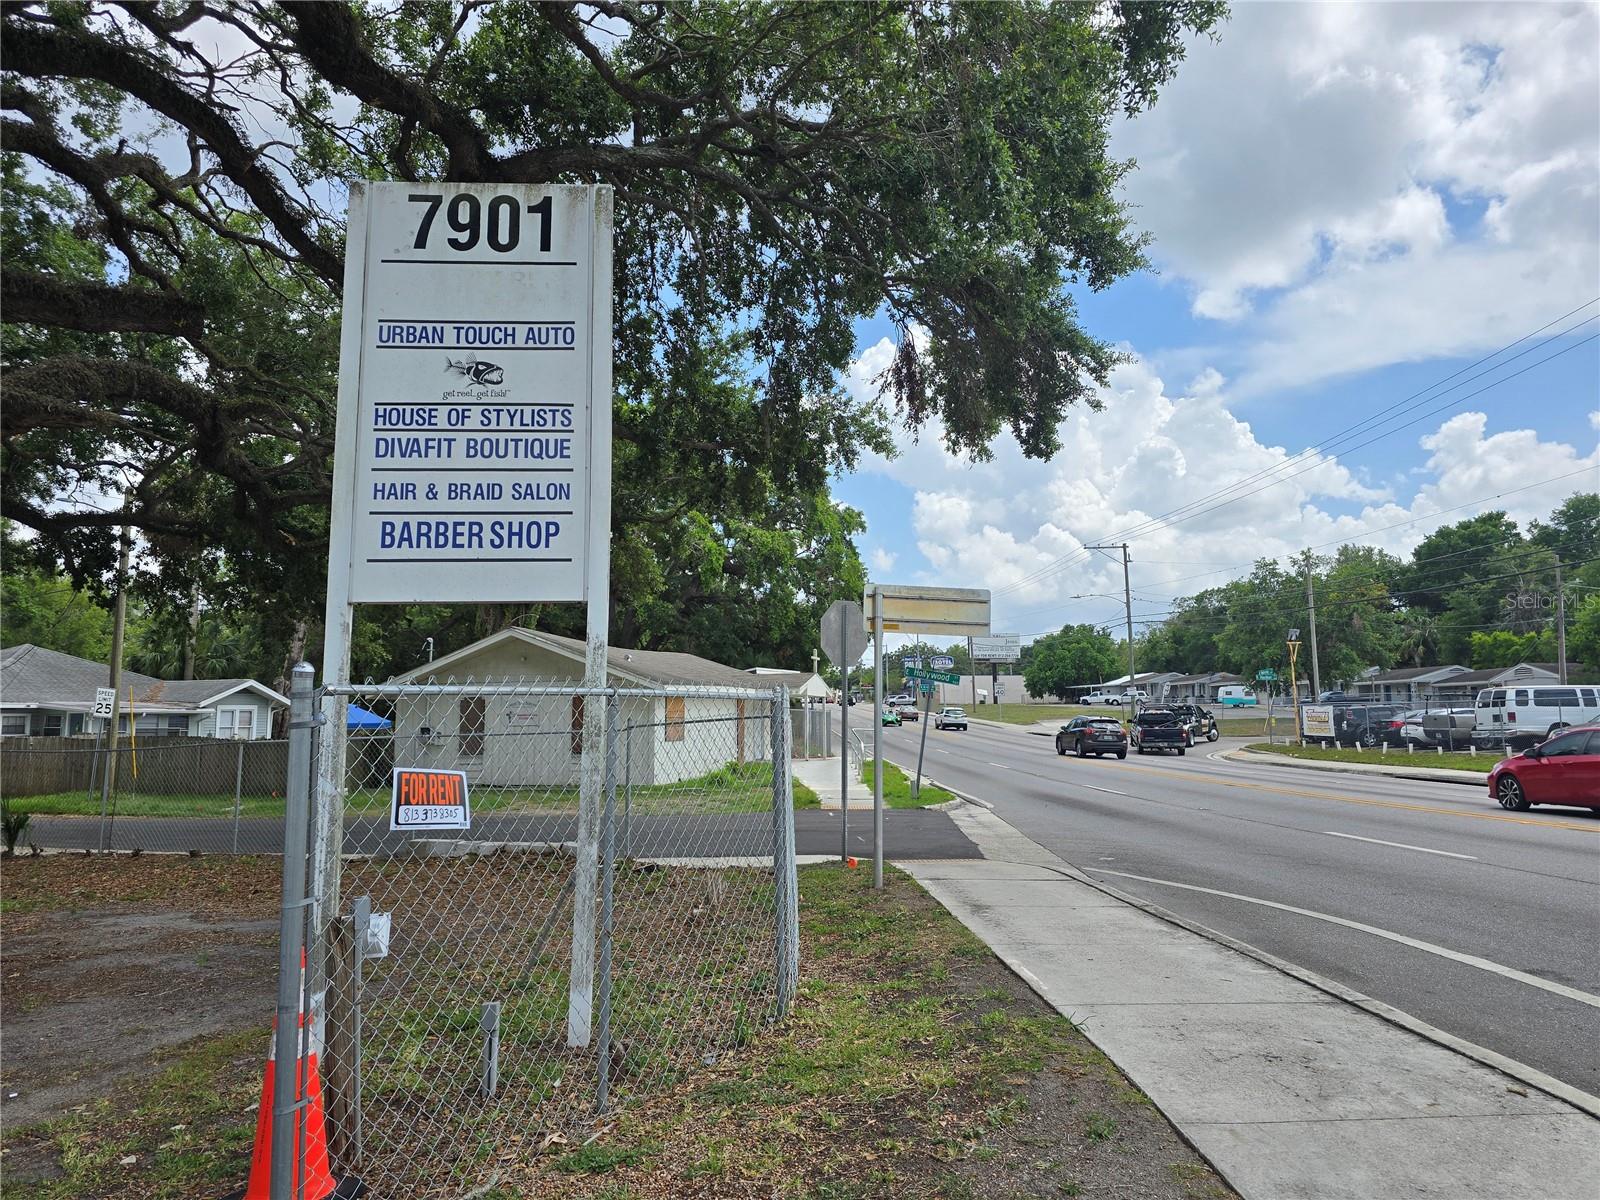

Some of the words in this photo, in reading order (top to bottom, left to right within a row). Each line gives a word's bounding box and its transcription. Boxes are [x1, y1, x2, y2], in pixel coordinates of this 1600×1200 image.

[408, 193, 553, 253] 7901
[378, 325, 445, 345] URBAN
[453, 326, 517, 345] TOUCH
[524, 326, 576, 346] AUTO
[442, 390, 456, 400] get
[374, 407, 439, 427] HOUSE
[447, 408, 472, 427] OF
[480, 408, 573, 428] STYLISTS
[375, 437, 457, 459] DIVAFIT
[465, 438, 572, 461] BOUTIQUE
[373, 482, 418, 501] HAIR
[425, 483, 440, 501] &
[448, 483, 504, 501] BRAID
[511, 483, 572, 501] SALON
[914, 669, 950, 681] Hollywood
[96, 703, 111, 714] 25
[401, 773, 428, 804] FOR
[429, 774, 460, 805] RENT
